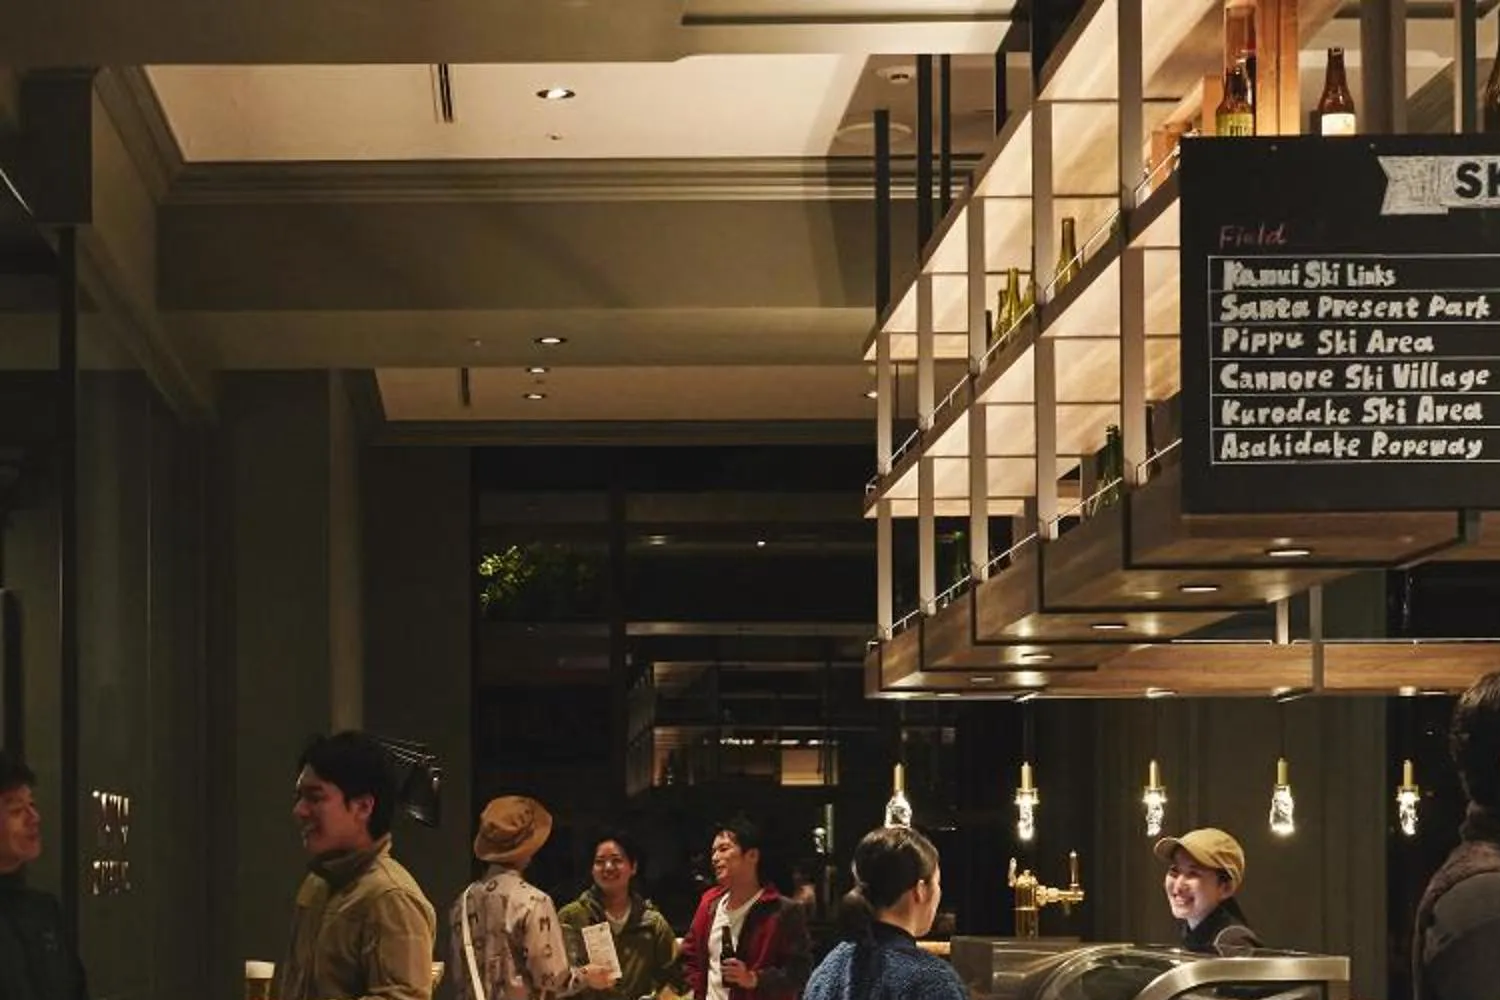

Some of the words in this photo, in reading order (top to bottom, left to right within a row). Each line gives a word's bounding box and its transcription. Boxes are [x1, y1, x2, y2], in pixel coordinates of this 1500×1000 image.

[1219, 223, 1287, 248] Field
[1222, 259, 1299, 290] Kamui
[1303, 260, 1340, 288] Ski
[1347, 263, 1396, 287] Links
[1220, 294, 1310, 321] Santa
[1317, 295, 1419, 319] Present
[1427, 294, 1491, 319] Park
[1222, 328, 1304, 354] Pippu
[1317, 329, 1357, 355] Ski
[1366, 329, 1435, 354] Area
[1219, 363, 1333, 390] Canmore
[1345, 364, 1384, 390] Ski
[1392, 362, 1491, 392] Village
[1221, 398, 1350, 426] Kurodake
[1361, 397, 1407, 425] Ski
[1416, 396, 1484, 424] Area
[1221, 430, 1361, 460] Asahidake
[1371, 431, 1483, 460] Ropeway
